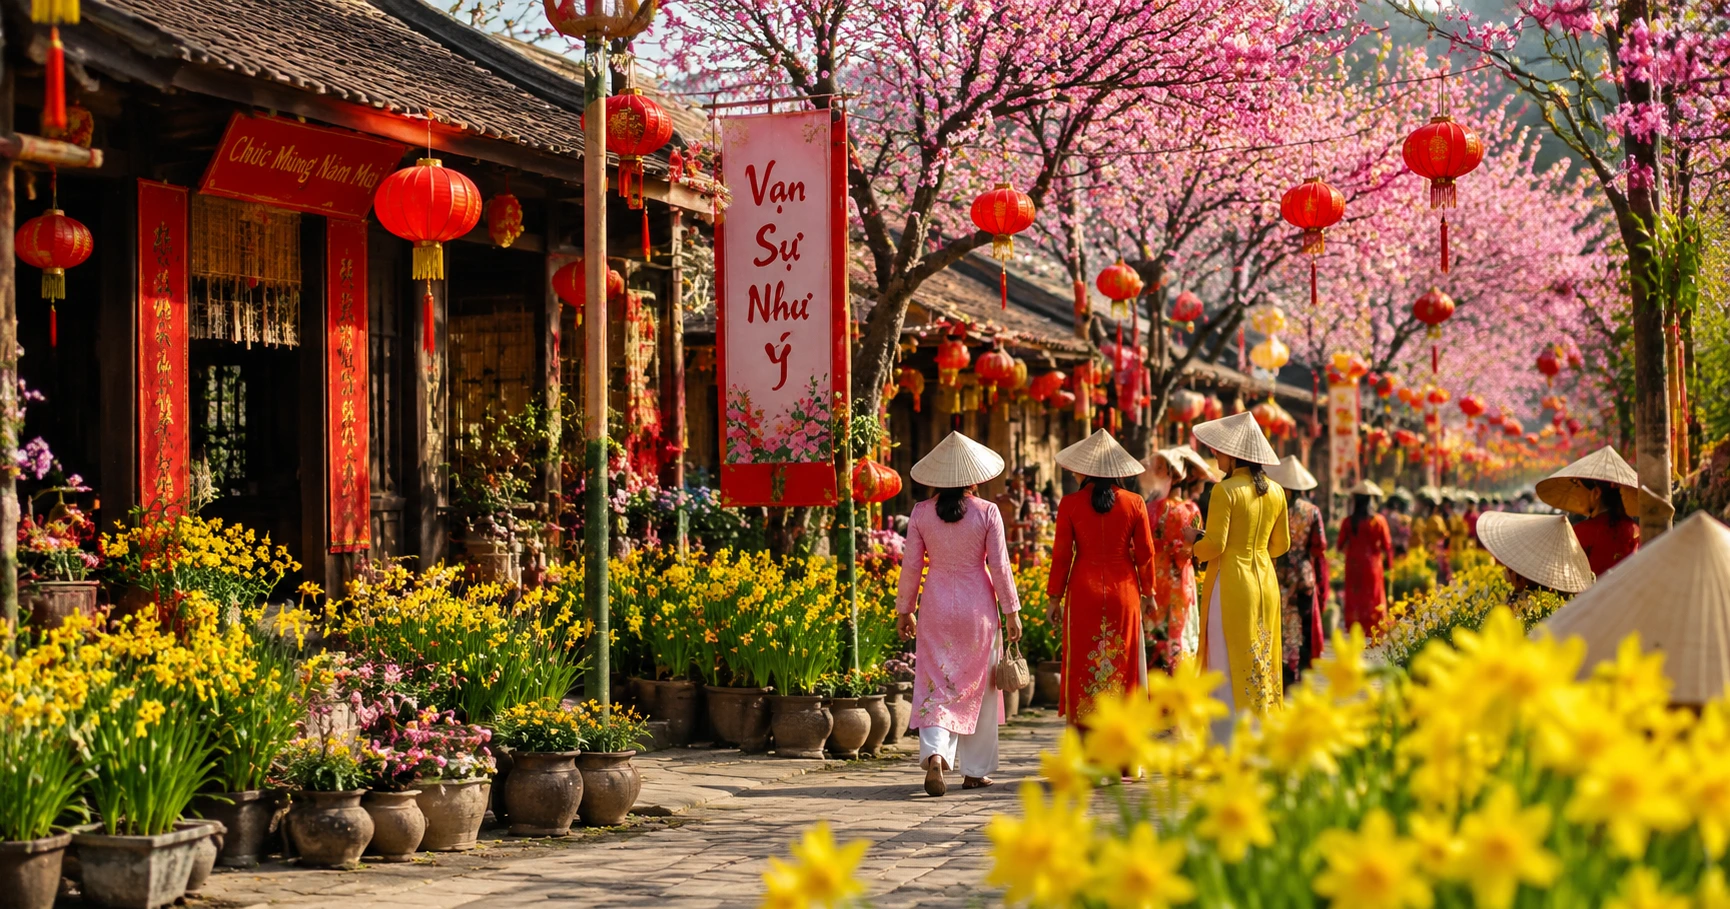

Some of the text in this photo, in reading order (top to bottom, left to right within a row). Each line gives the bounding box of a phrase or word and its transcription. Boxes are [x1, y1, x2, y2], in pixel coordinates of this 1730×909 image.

[229, 136, 272, 167] Chúc
[745, 160, 806, 214] Vạn
[753, 223, 804, 271] Sự
[748, 280, 814, 323] Như
